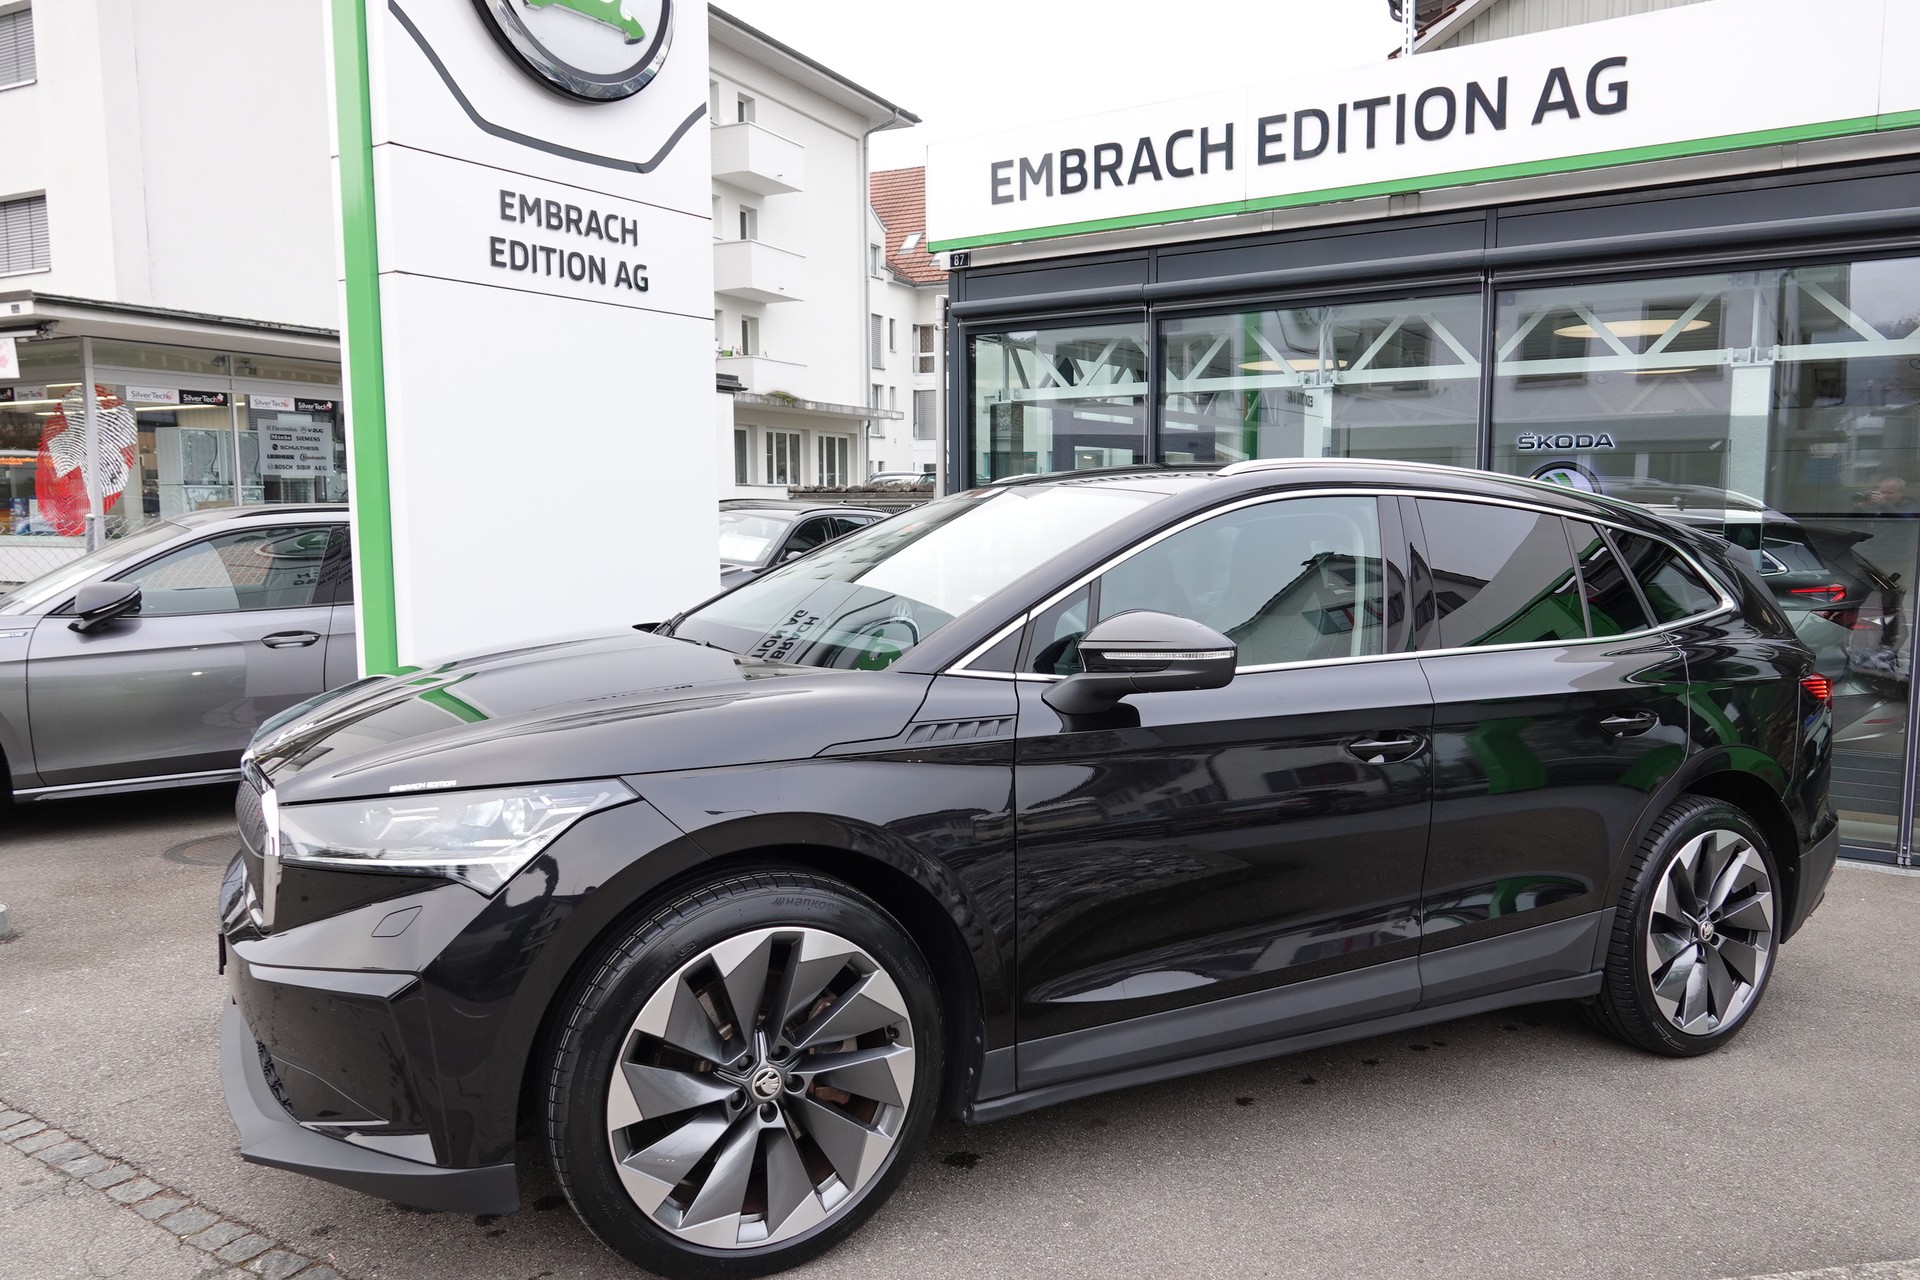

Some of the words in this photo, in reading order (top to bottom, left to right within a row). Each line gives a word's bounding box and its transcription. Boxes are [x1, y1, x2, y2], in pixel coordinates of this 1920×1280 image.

[991, 122, 1234, 206] EMBRACH
[1257, 75, 1508, 167] EDITION
[1531, 55, 1630, 127] AG
[500, 189, 638, 248] EMBRACH
[490, 236, 606, 286] EDITION
[614, 260, 649, 292] AG
[954, 254, 965, 266] 87
[1518, 432, 1614, 450] ŠKODA
